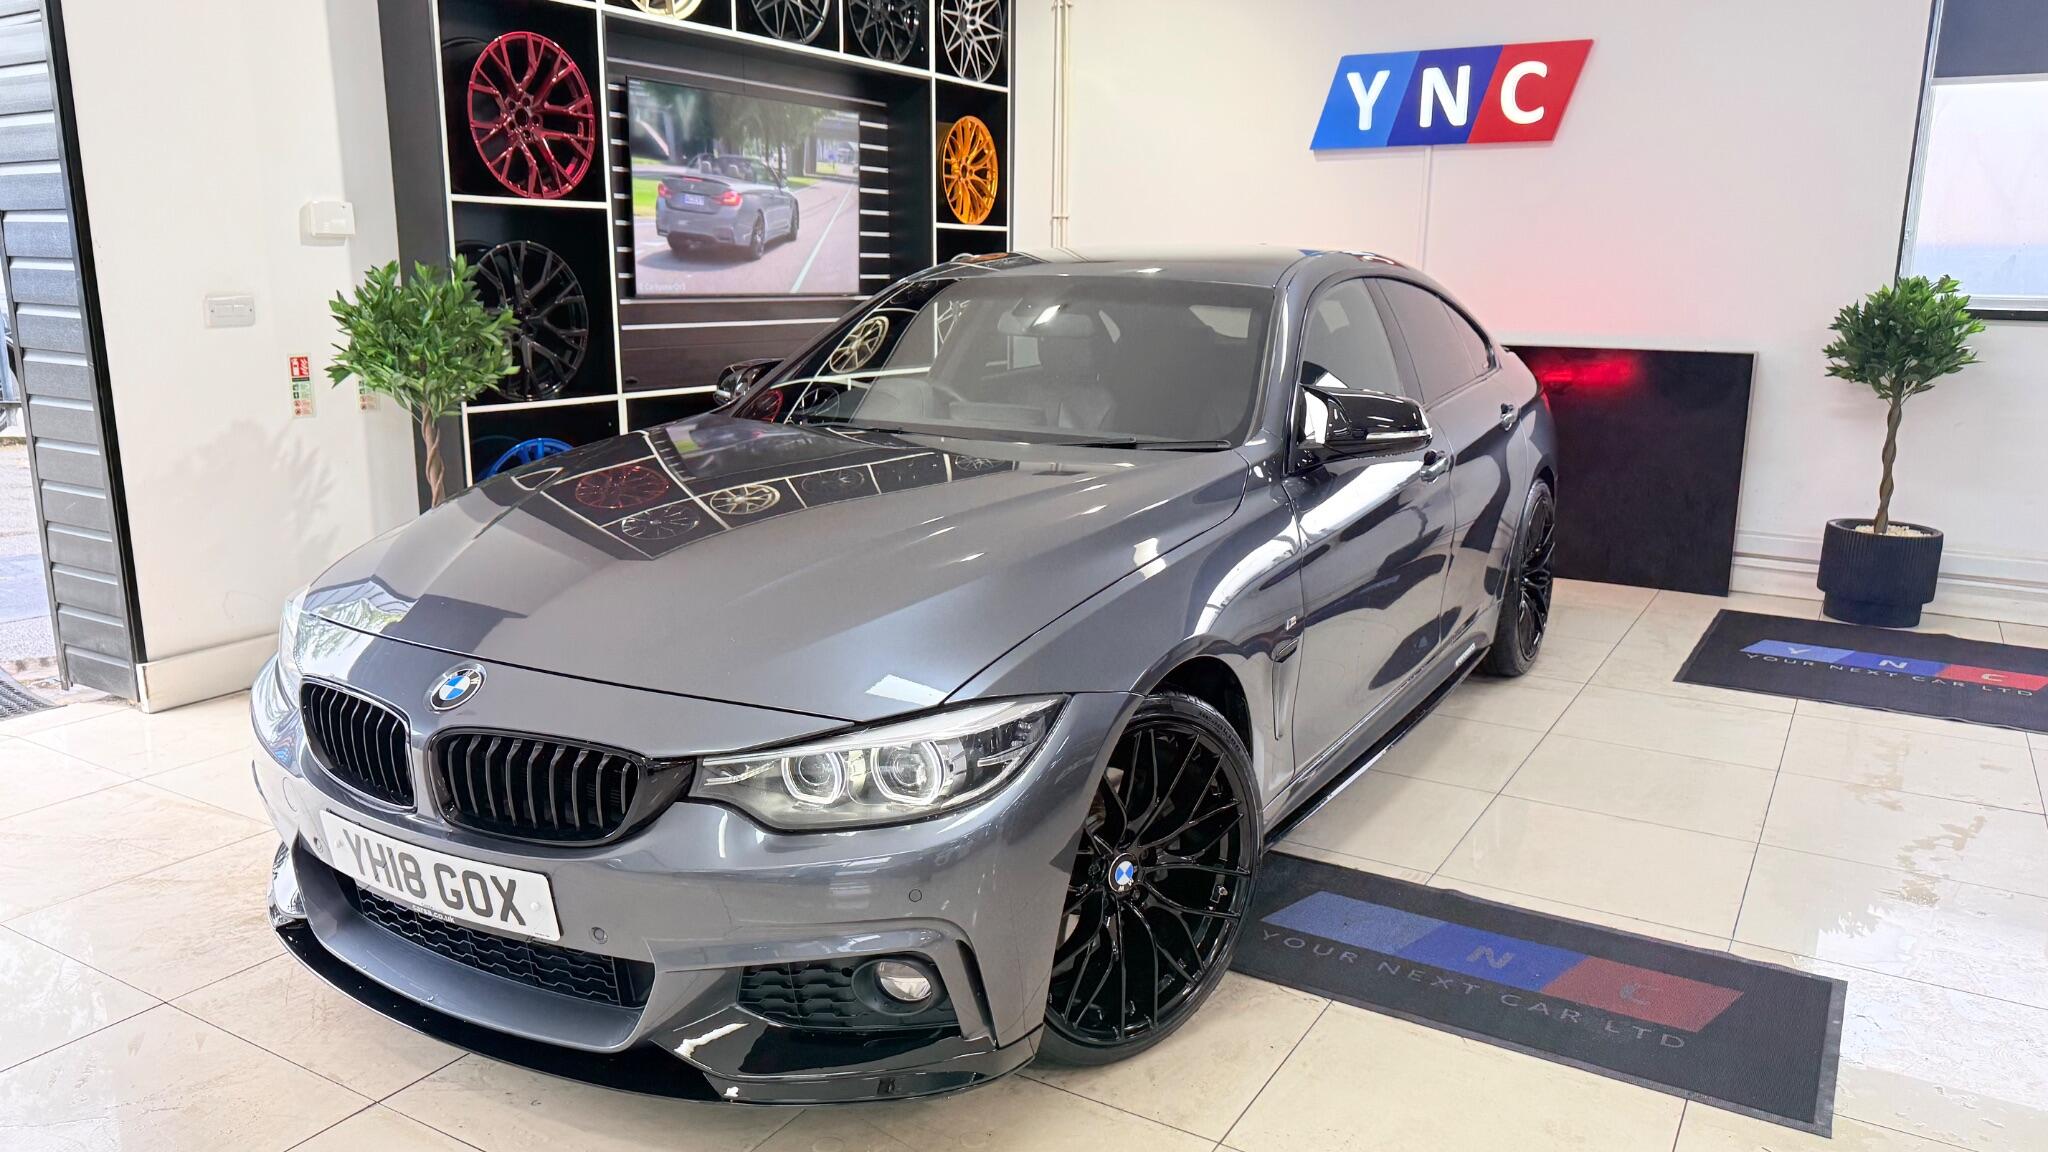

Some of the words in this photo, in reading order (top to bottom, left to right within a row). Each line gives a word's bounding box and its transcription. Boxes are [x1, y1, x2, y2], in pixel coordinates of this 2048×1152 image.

[1347, 60, 1548, 131] YNC
[1747, 653, 1814, 666] YOUR
[1829, 664, 1898, 677] NEXT
[1912, 675, 1966, 688] CAR
[1982, 685, 2033, 697] LTD
[342, 829, 427, 899] YH18
[433, 862, 527, 926] GOX
[1263, 929, 1359, 965] YOUR
[1377, 961, 1481, 995] NEXT
[1500, 994, 1584, 1024] CAR
[1604, 1019, 1687, 1050] LTD
